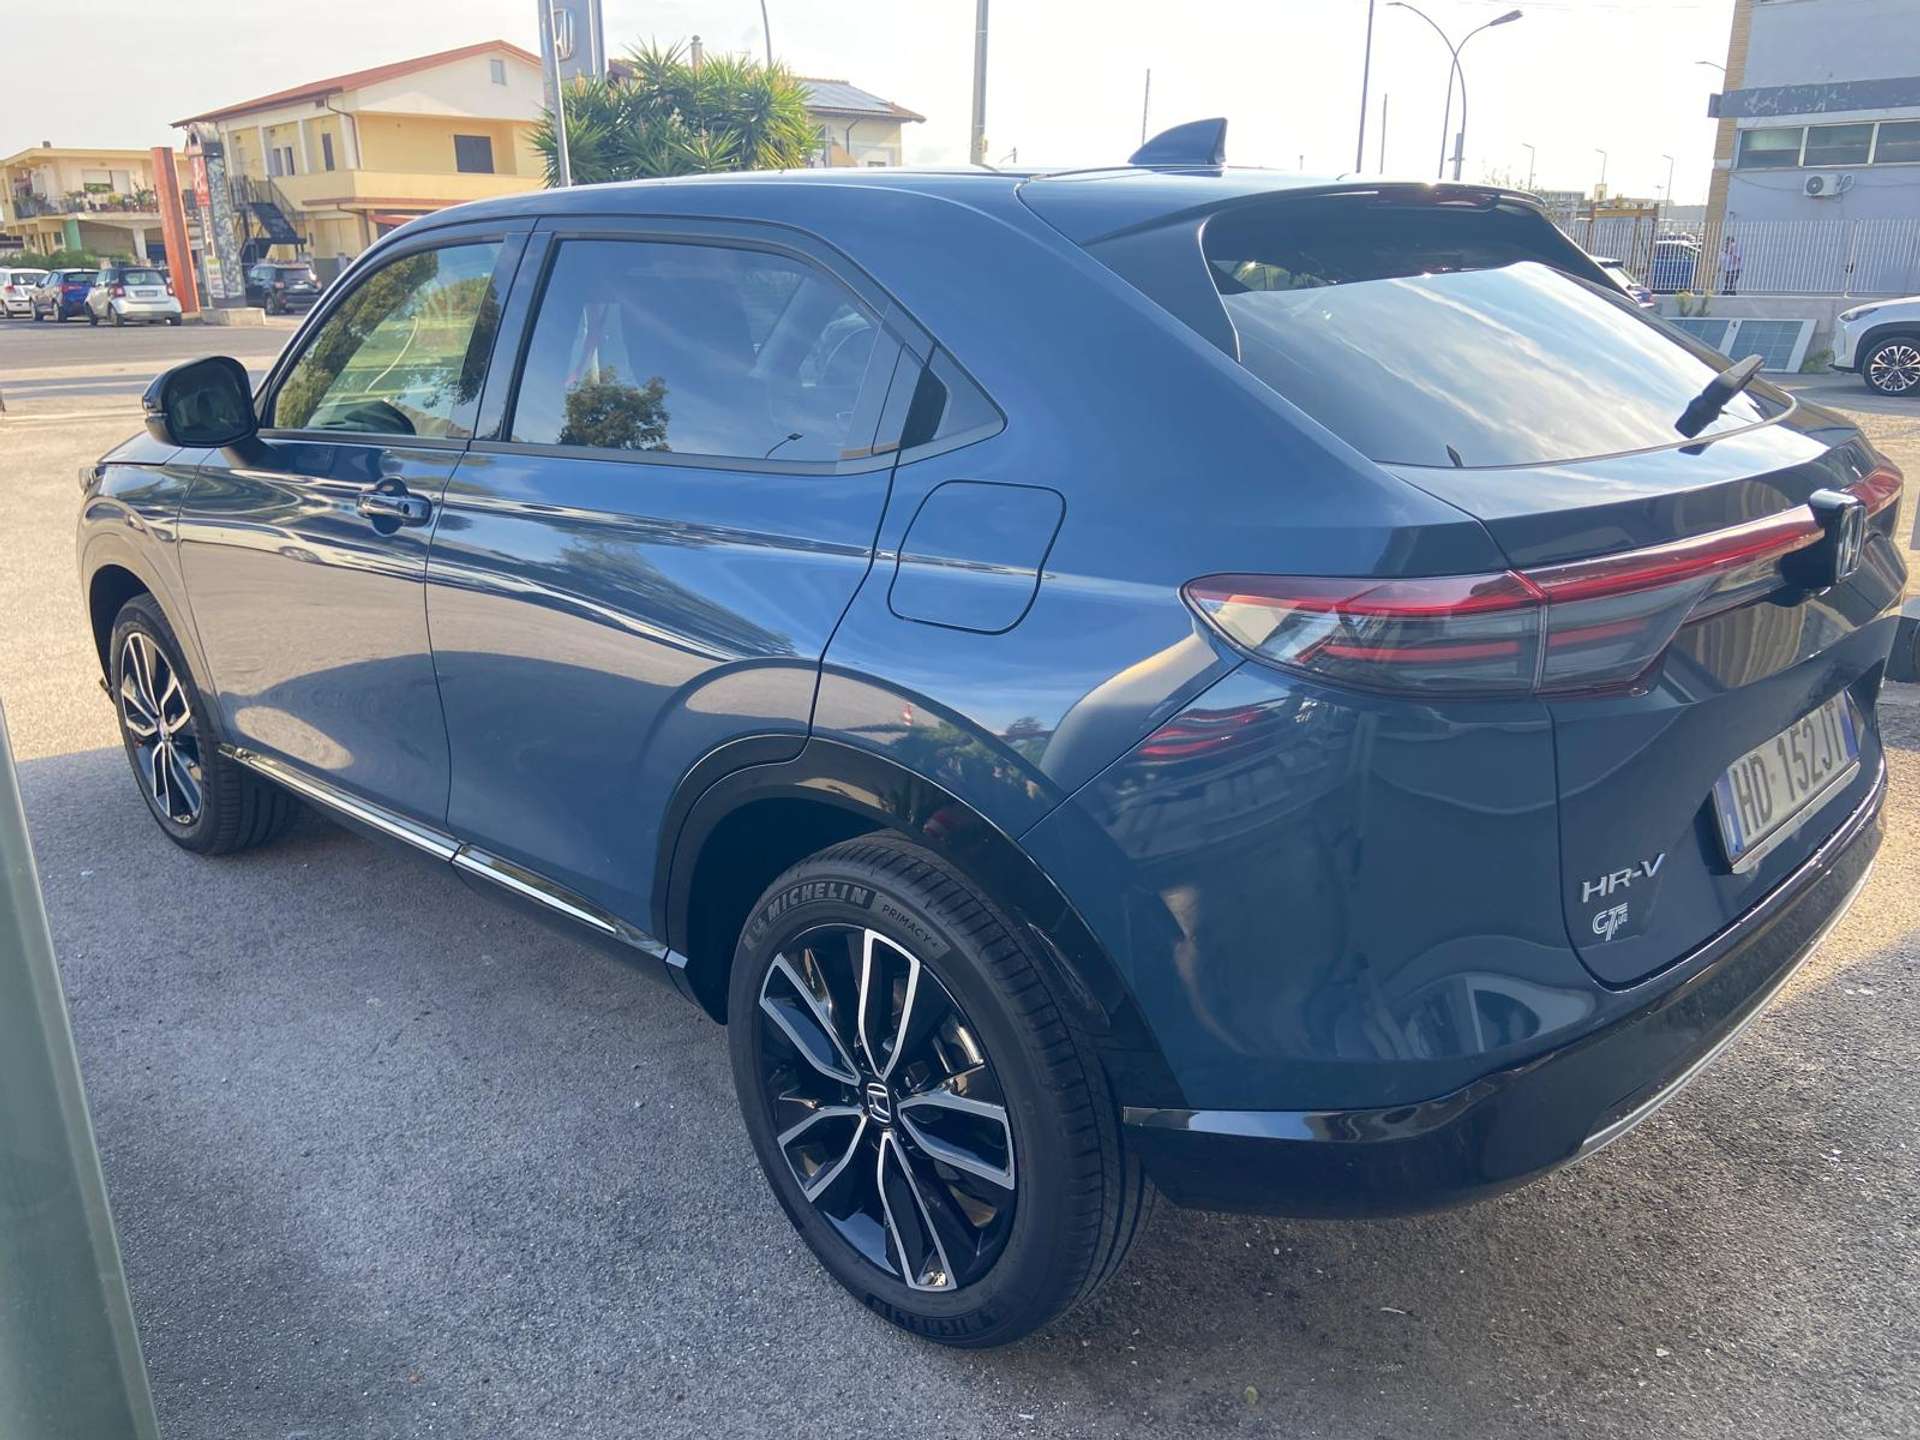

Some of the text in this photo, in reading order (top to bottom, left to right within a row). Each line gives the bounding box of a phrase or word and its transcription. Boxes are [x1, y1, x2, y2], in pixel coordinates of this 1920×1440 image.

[1734, 753, 1773, 836] HD
[1583, 853, 1665, 904] HR-V
[767, 882, 869, 922] MICHELIN
[881, 903, 932, 943] PRIMACY
